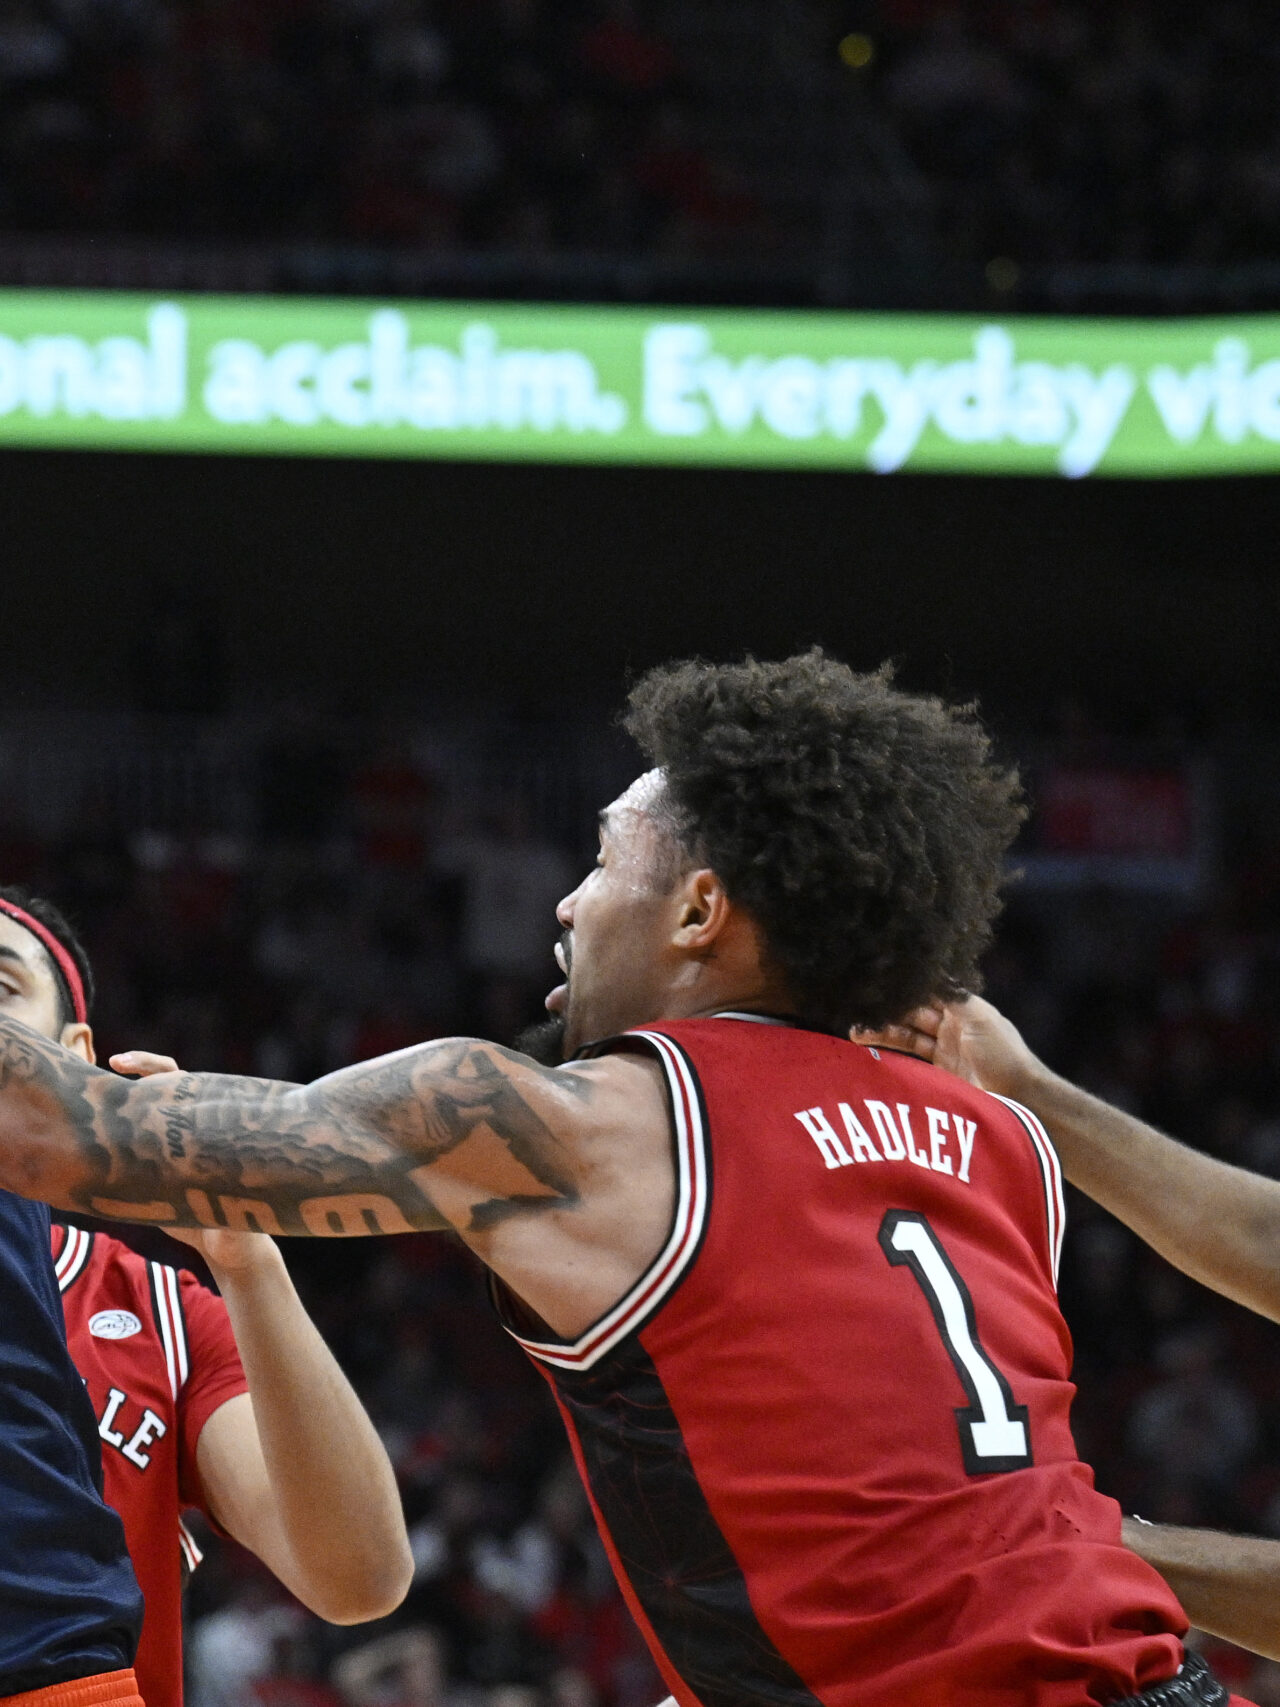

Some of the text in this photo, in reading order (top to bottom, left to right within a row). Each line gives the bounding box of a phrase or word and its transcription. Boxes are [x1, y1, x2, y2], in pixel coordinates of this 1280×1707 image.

[204, 307, 627, 434] acclaim.
[642, 322, 1135, 478] Everyday
[793, 1098, 978, 1184] HADLEY
[879, 1209, 1033, 1474] 1
[90, 1383, 168, 1470] LE
